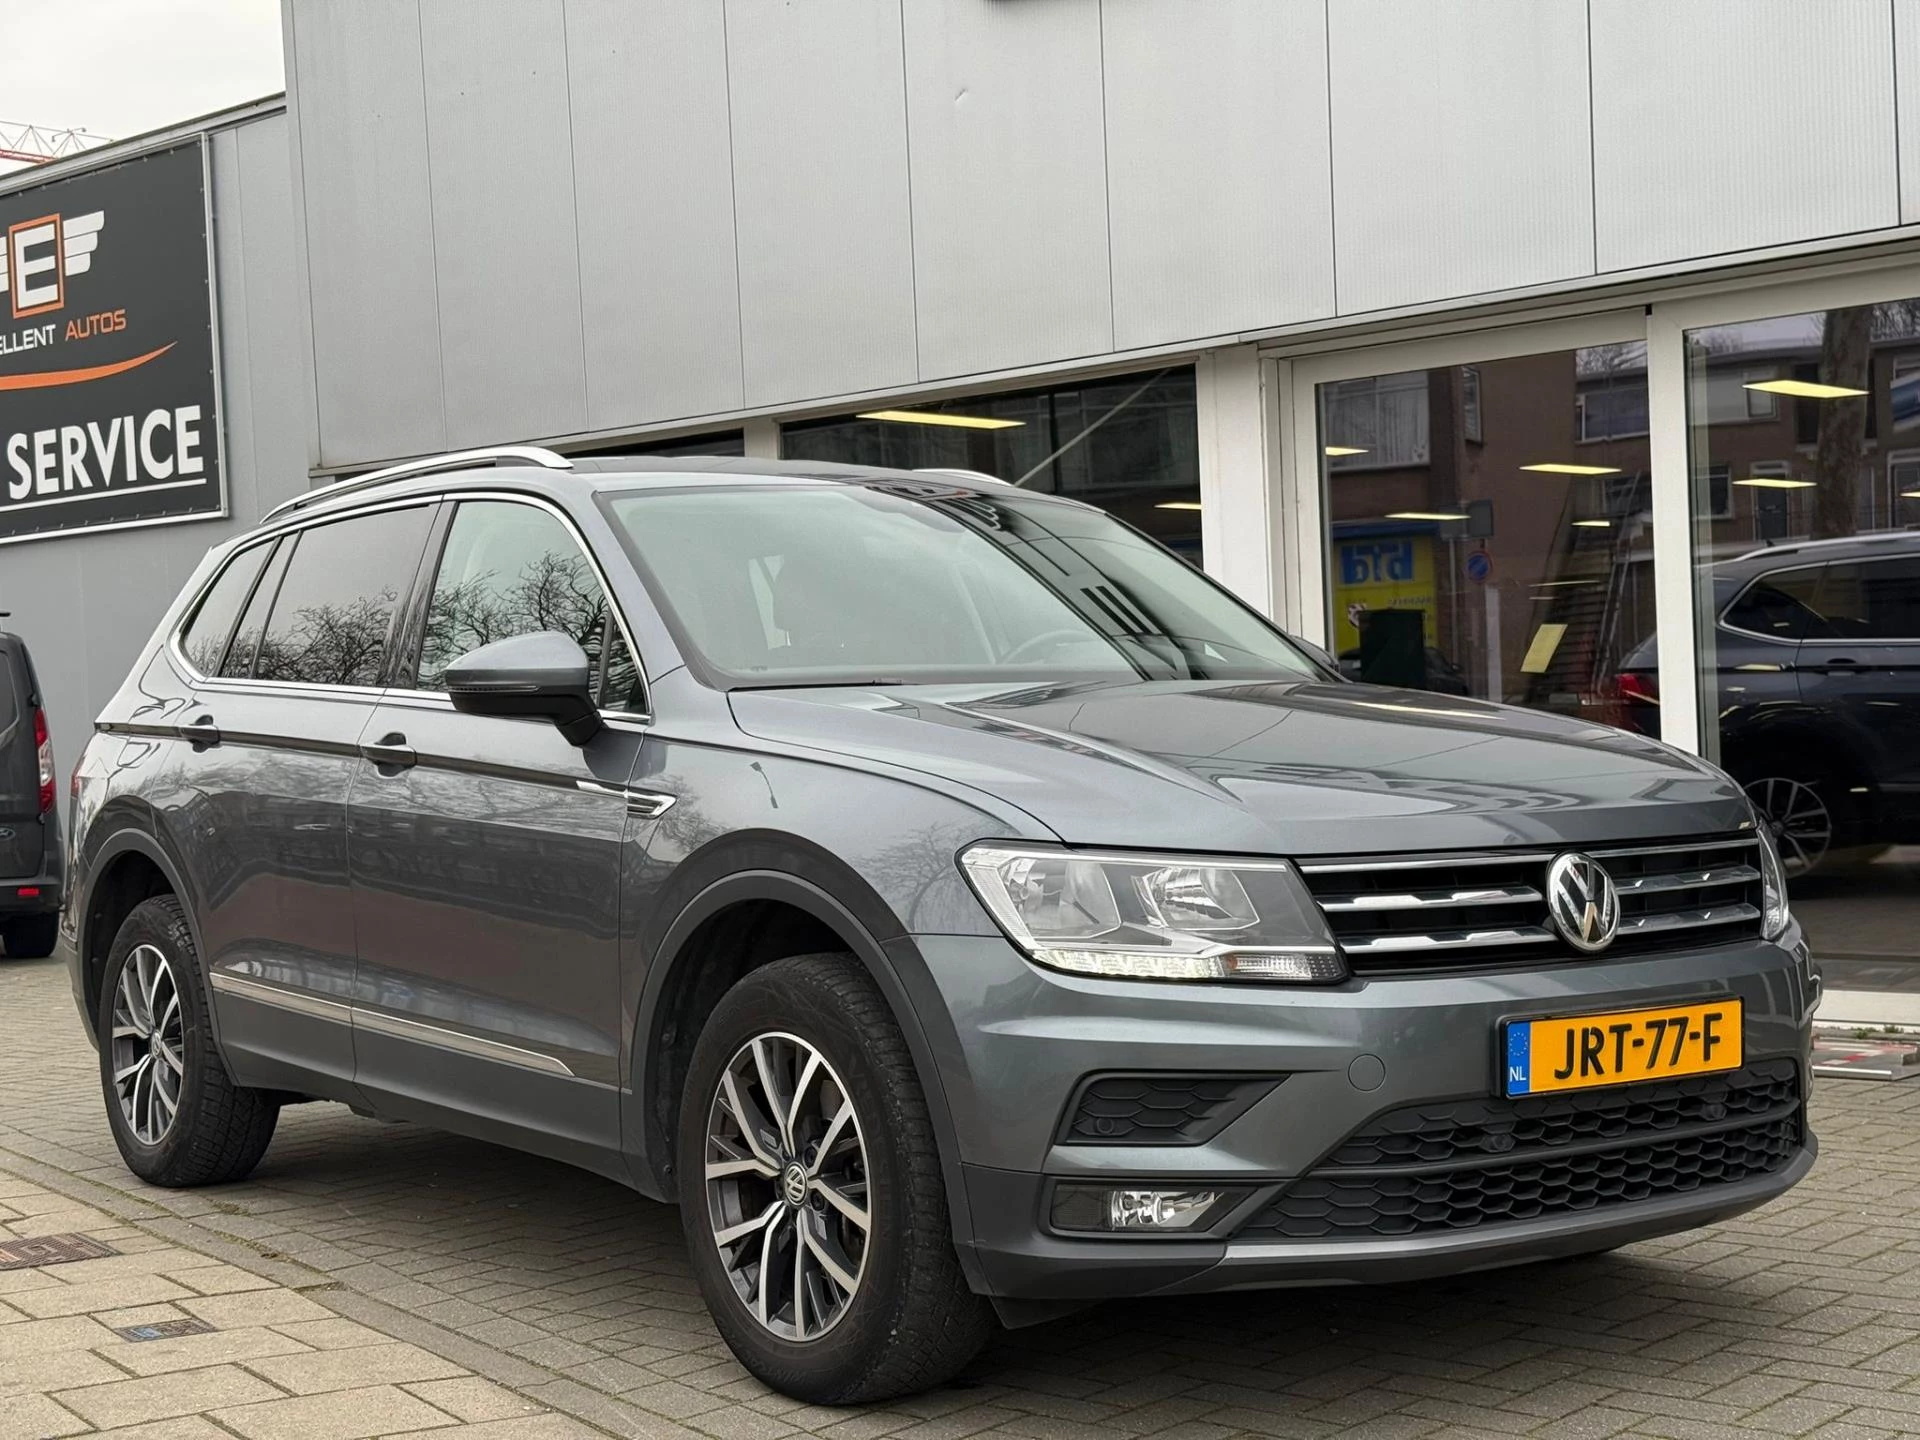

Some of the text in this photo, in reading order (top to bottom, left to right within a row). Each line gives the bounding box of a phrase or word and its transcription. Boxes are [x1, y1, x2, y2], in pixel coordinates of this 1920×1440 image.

[14, 225, 58, 309] E
[65, 309, 127, 341] AUTOS
[7, 405, 204, 500] SERVICE
[1508, 1013, 1723, 1081] NL JRT-77-F
